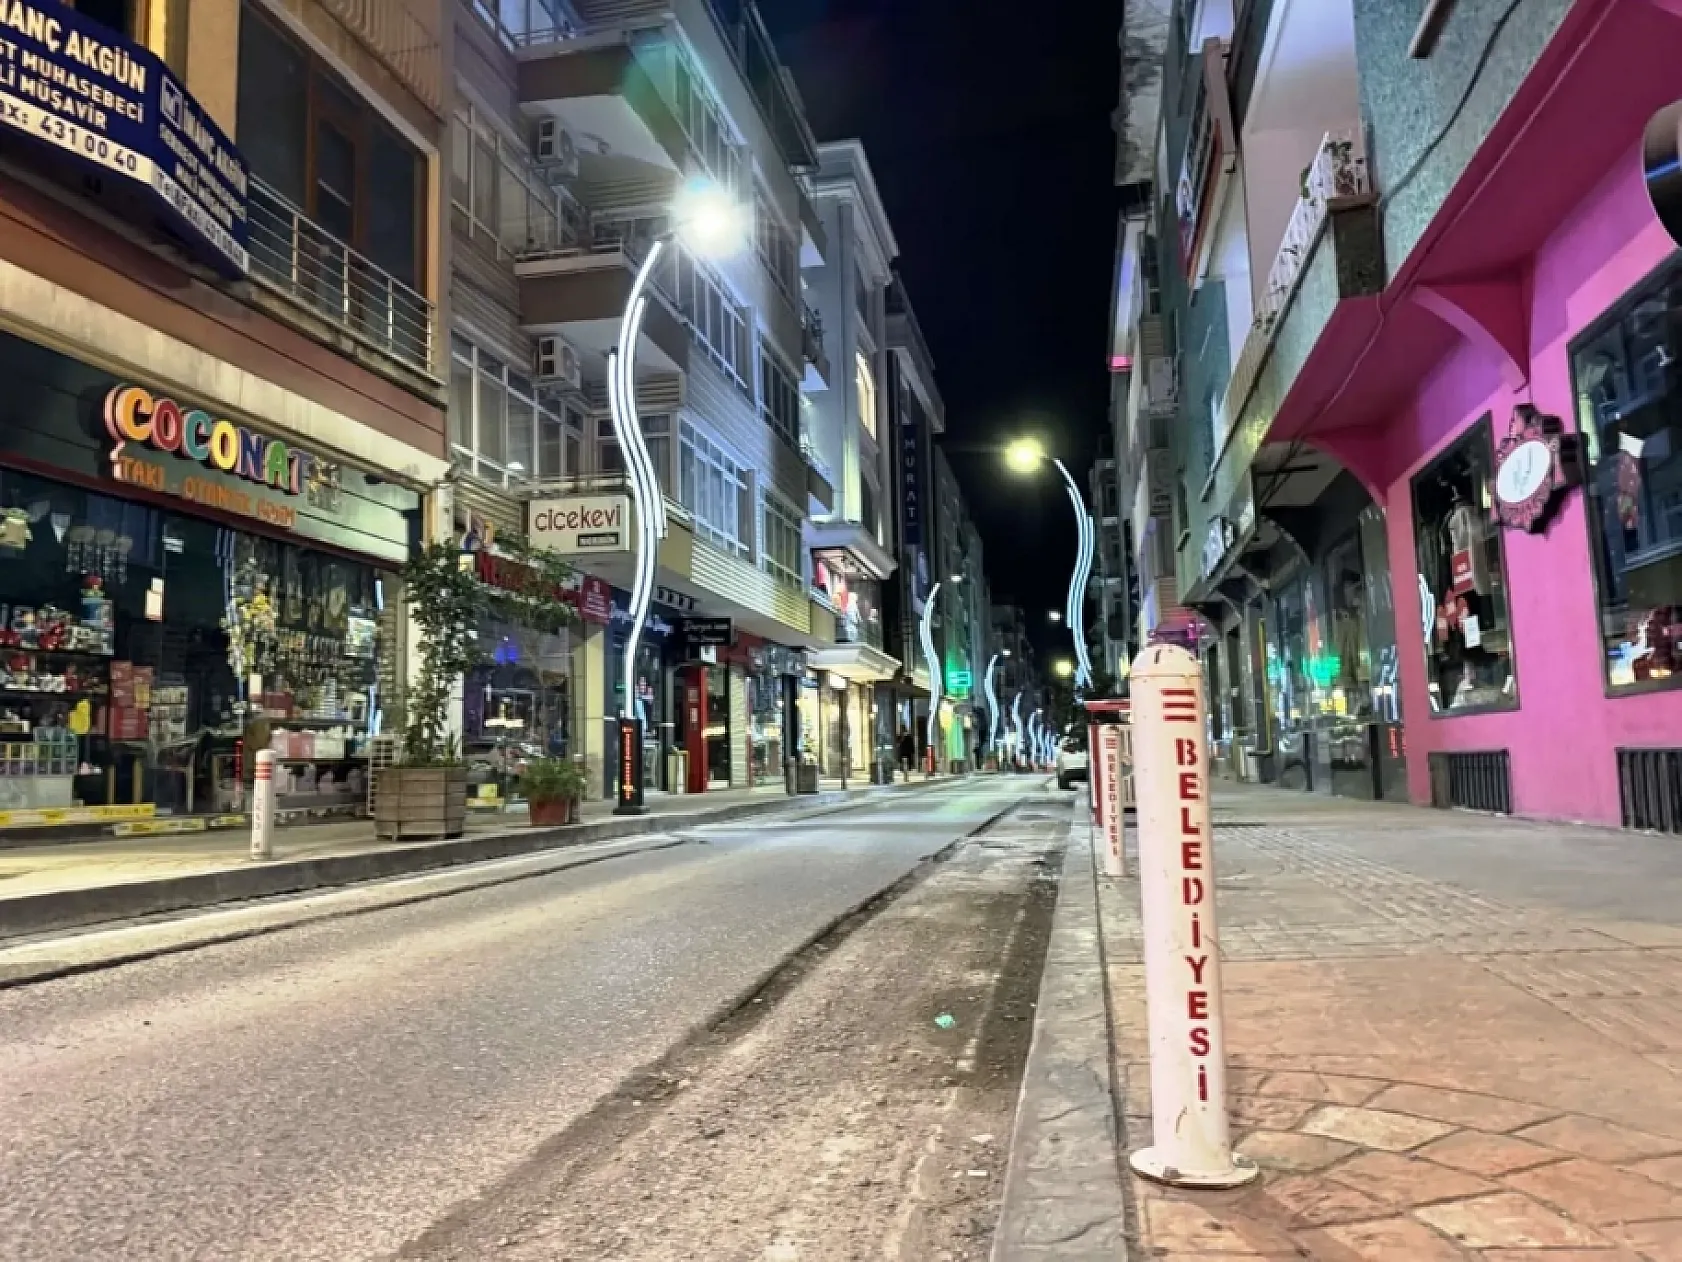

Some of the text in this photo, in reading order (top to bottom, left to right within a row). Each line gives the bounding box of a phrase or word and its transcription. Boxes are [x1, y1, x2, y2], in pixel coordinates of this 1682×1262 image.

[21, 49, 145, 123] MUHASEBECİ
[64, 30, 147, 94] AKGÜN
[41, 115, 76, 146] 431
[85, 135, 107, 158] 00
[114, 149, 137, 171] 40
[1174, 738, 1211, 1102] BELEDİYESİ
